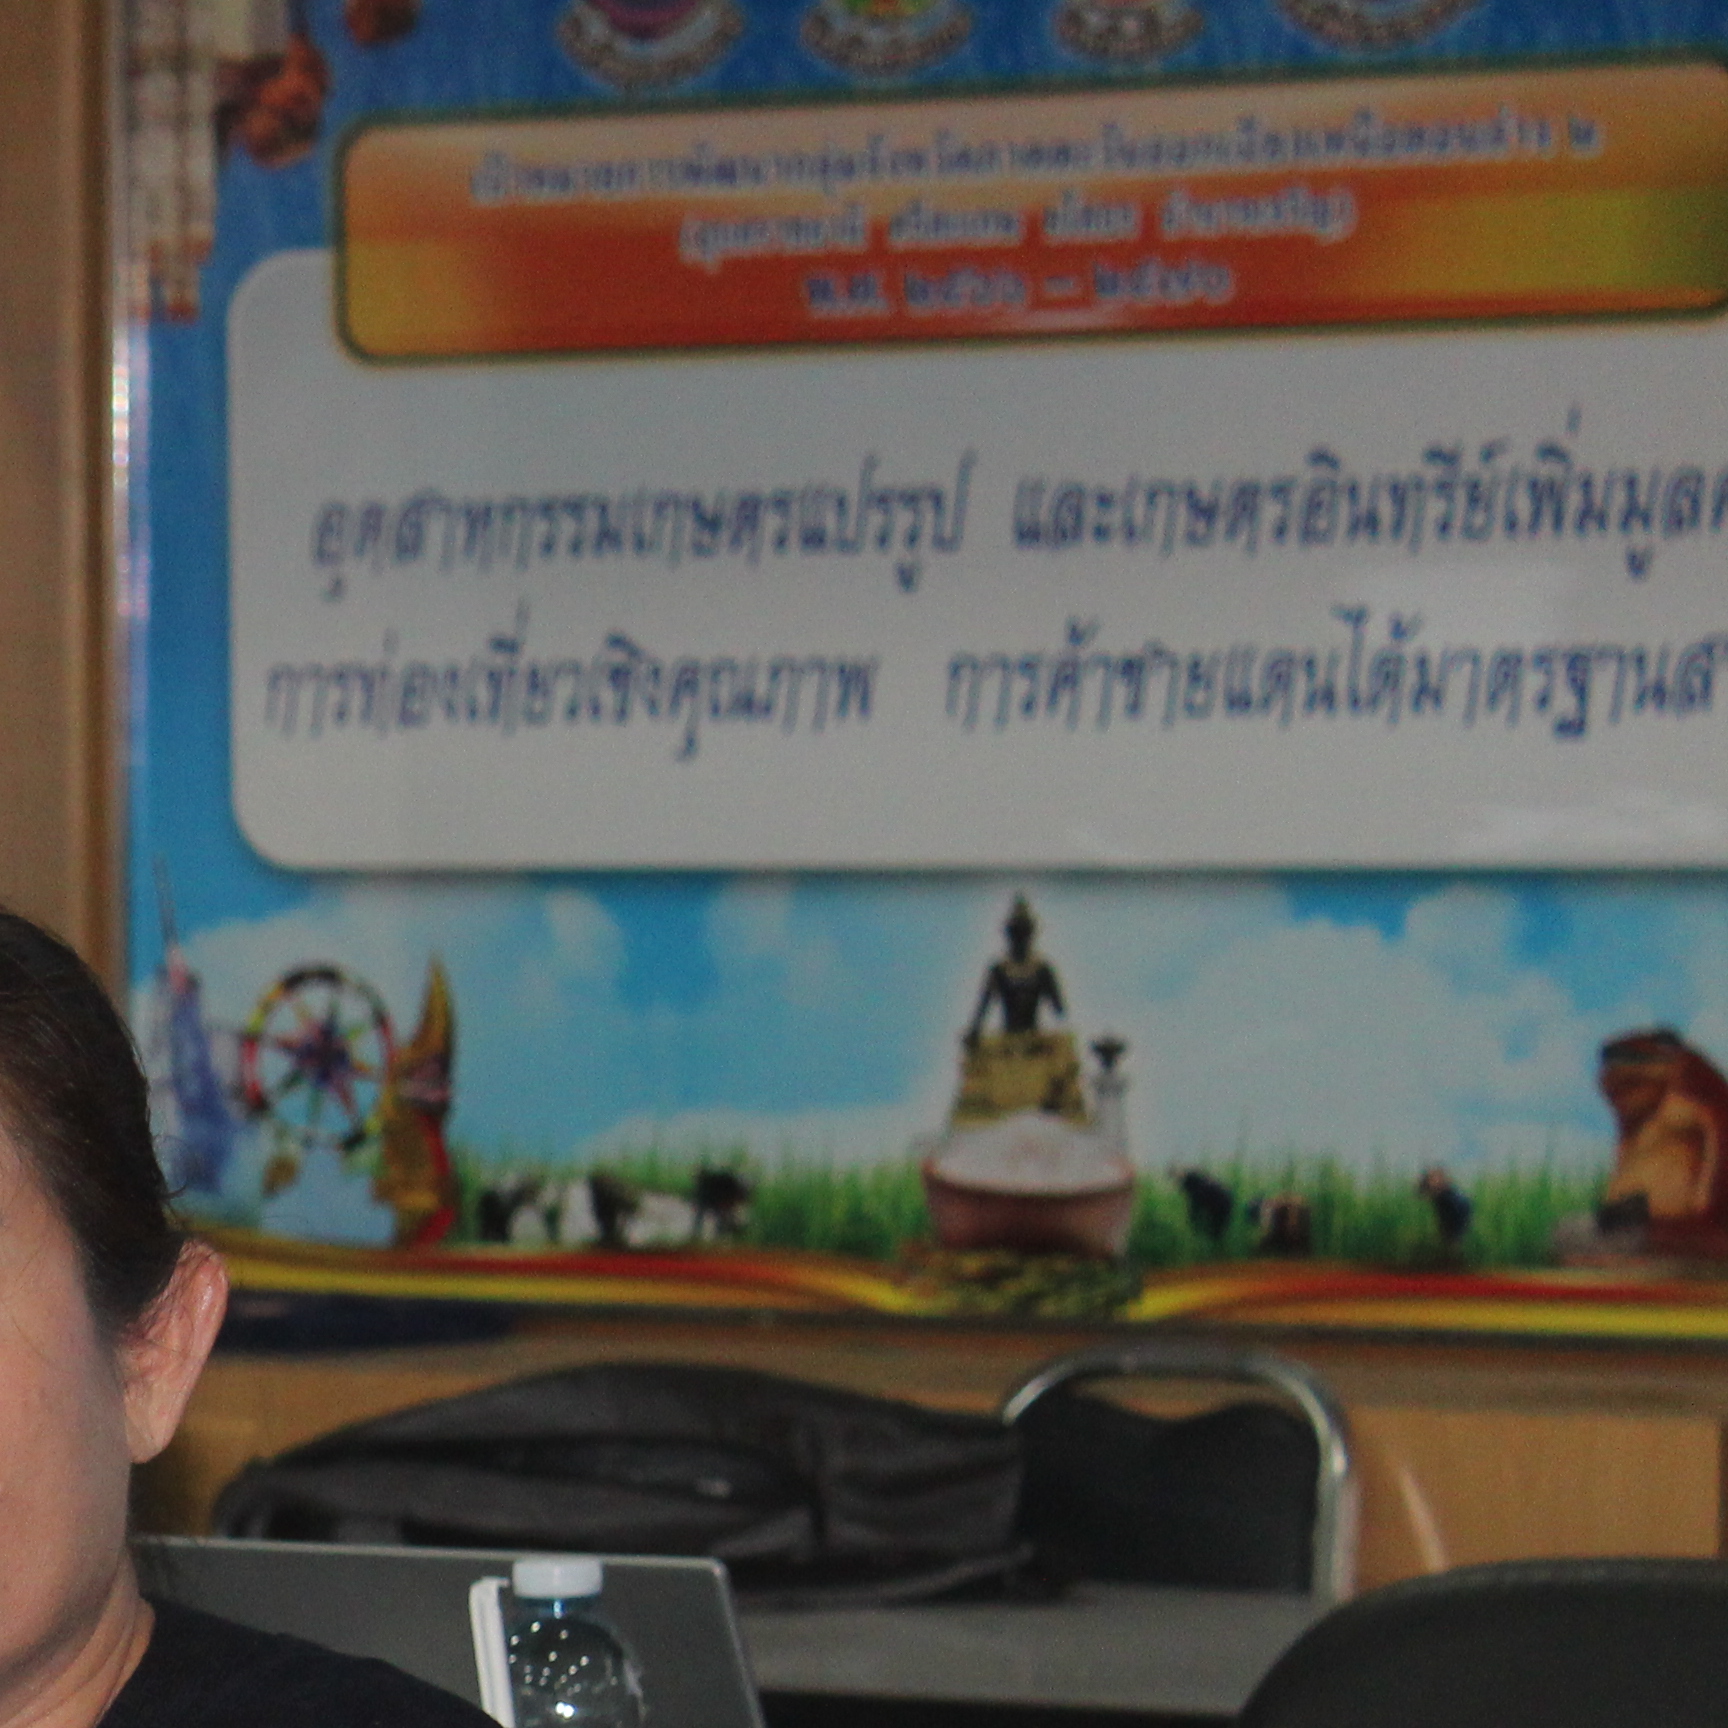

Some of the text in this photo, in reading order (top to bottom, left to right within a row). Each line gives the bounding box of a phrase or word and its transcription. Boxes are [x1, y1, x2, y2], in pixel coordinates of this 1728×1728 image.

[945, 603, 1728, 740] การค้าชายแดนได้มาตรฐานส
